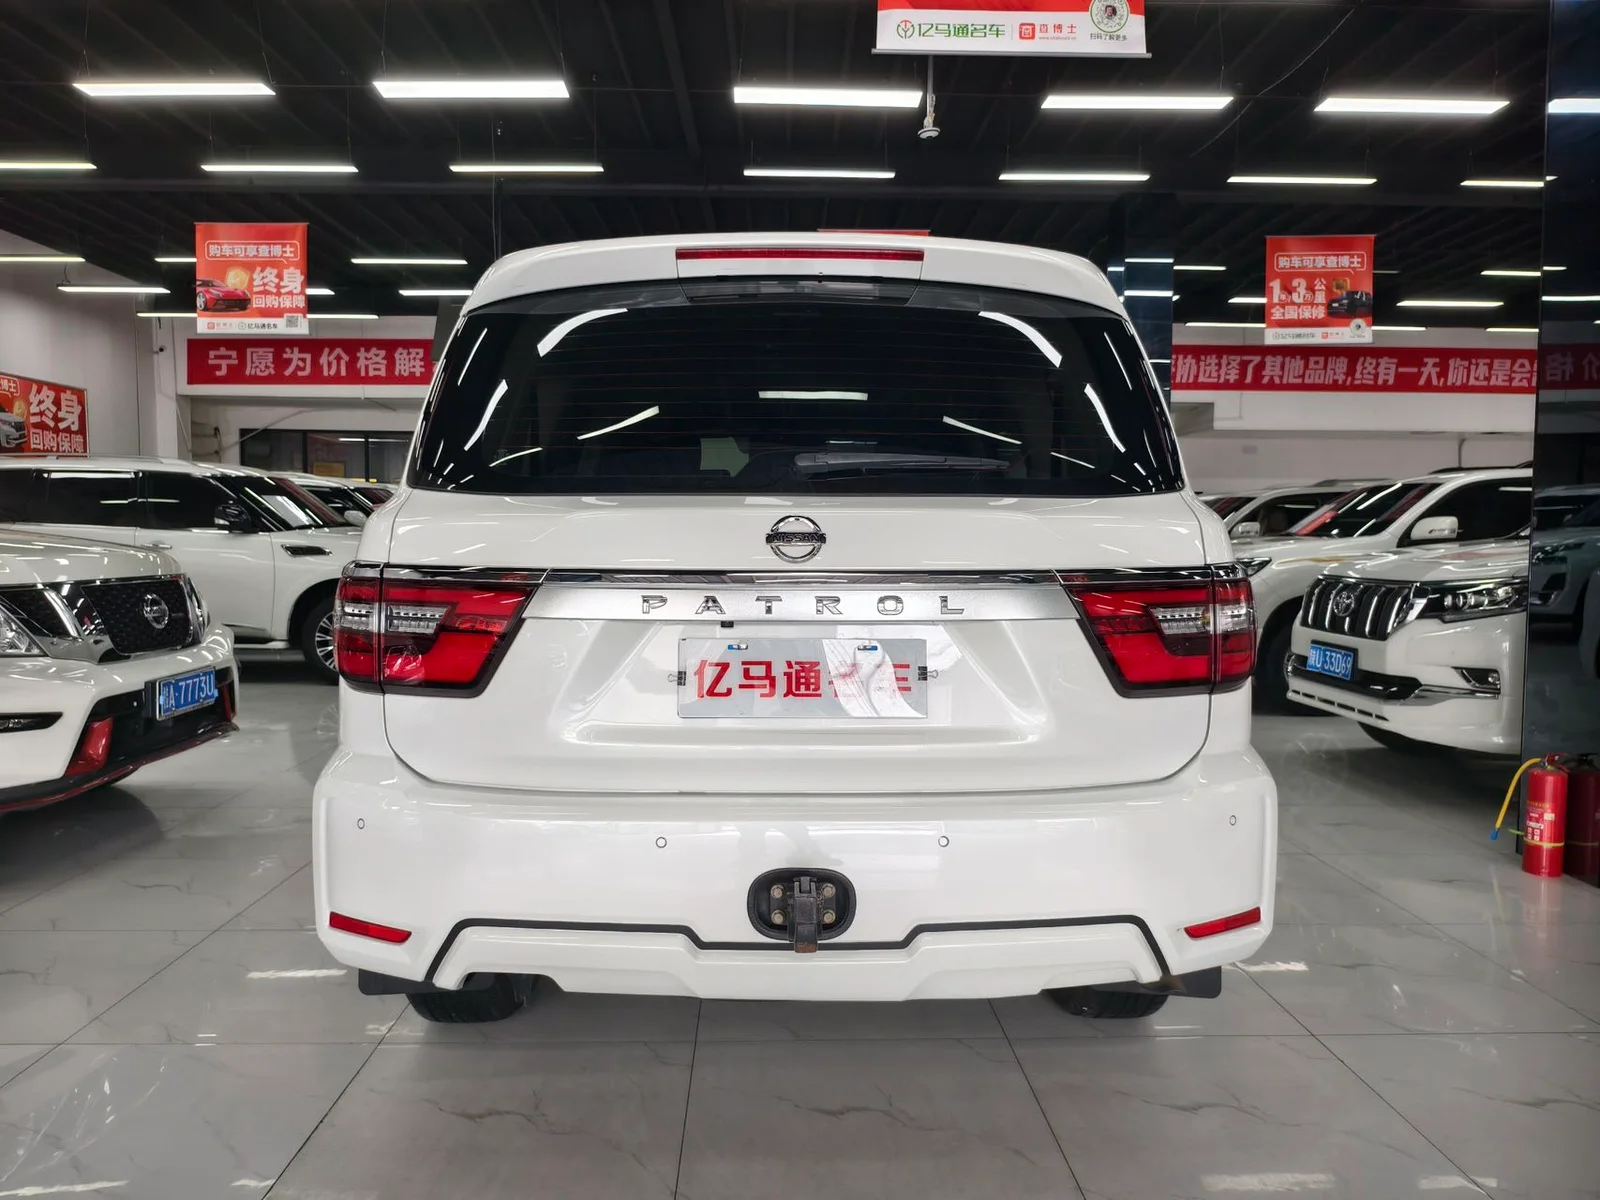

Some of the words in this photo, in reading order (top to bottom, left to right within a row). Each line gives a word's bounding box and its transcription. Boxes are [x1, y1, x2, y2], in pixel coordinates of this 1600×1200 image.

[917, 22, 1006, 39] 亿马通名车
[1038, 23, 1077, 34] 查博士
[208, 244, 296, 257] 购车可享查博士
[1278, 255, 1362, 268] 购车可享查博士
[253, 267, 305, 294] 终身
[252, 295, 306, 309] 回购保障
[1270, 305, 1326, 320] 全国保修
[208, 347, 437, 377] 宁愿为价格解
[1171, 354, 1538, 388] 协选择了其他品牌,终有一天,你还是会
[29, 382, 82, 431] 终身
[30, 427, 84, 454] 回购保障
[773, 533, 819, 542] NISSAN
[641, 594, 965, 616] PATROL
[694, 658, 912, 699] 亿马通
